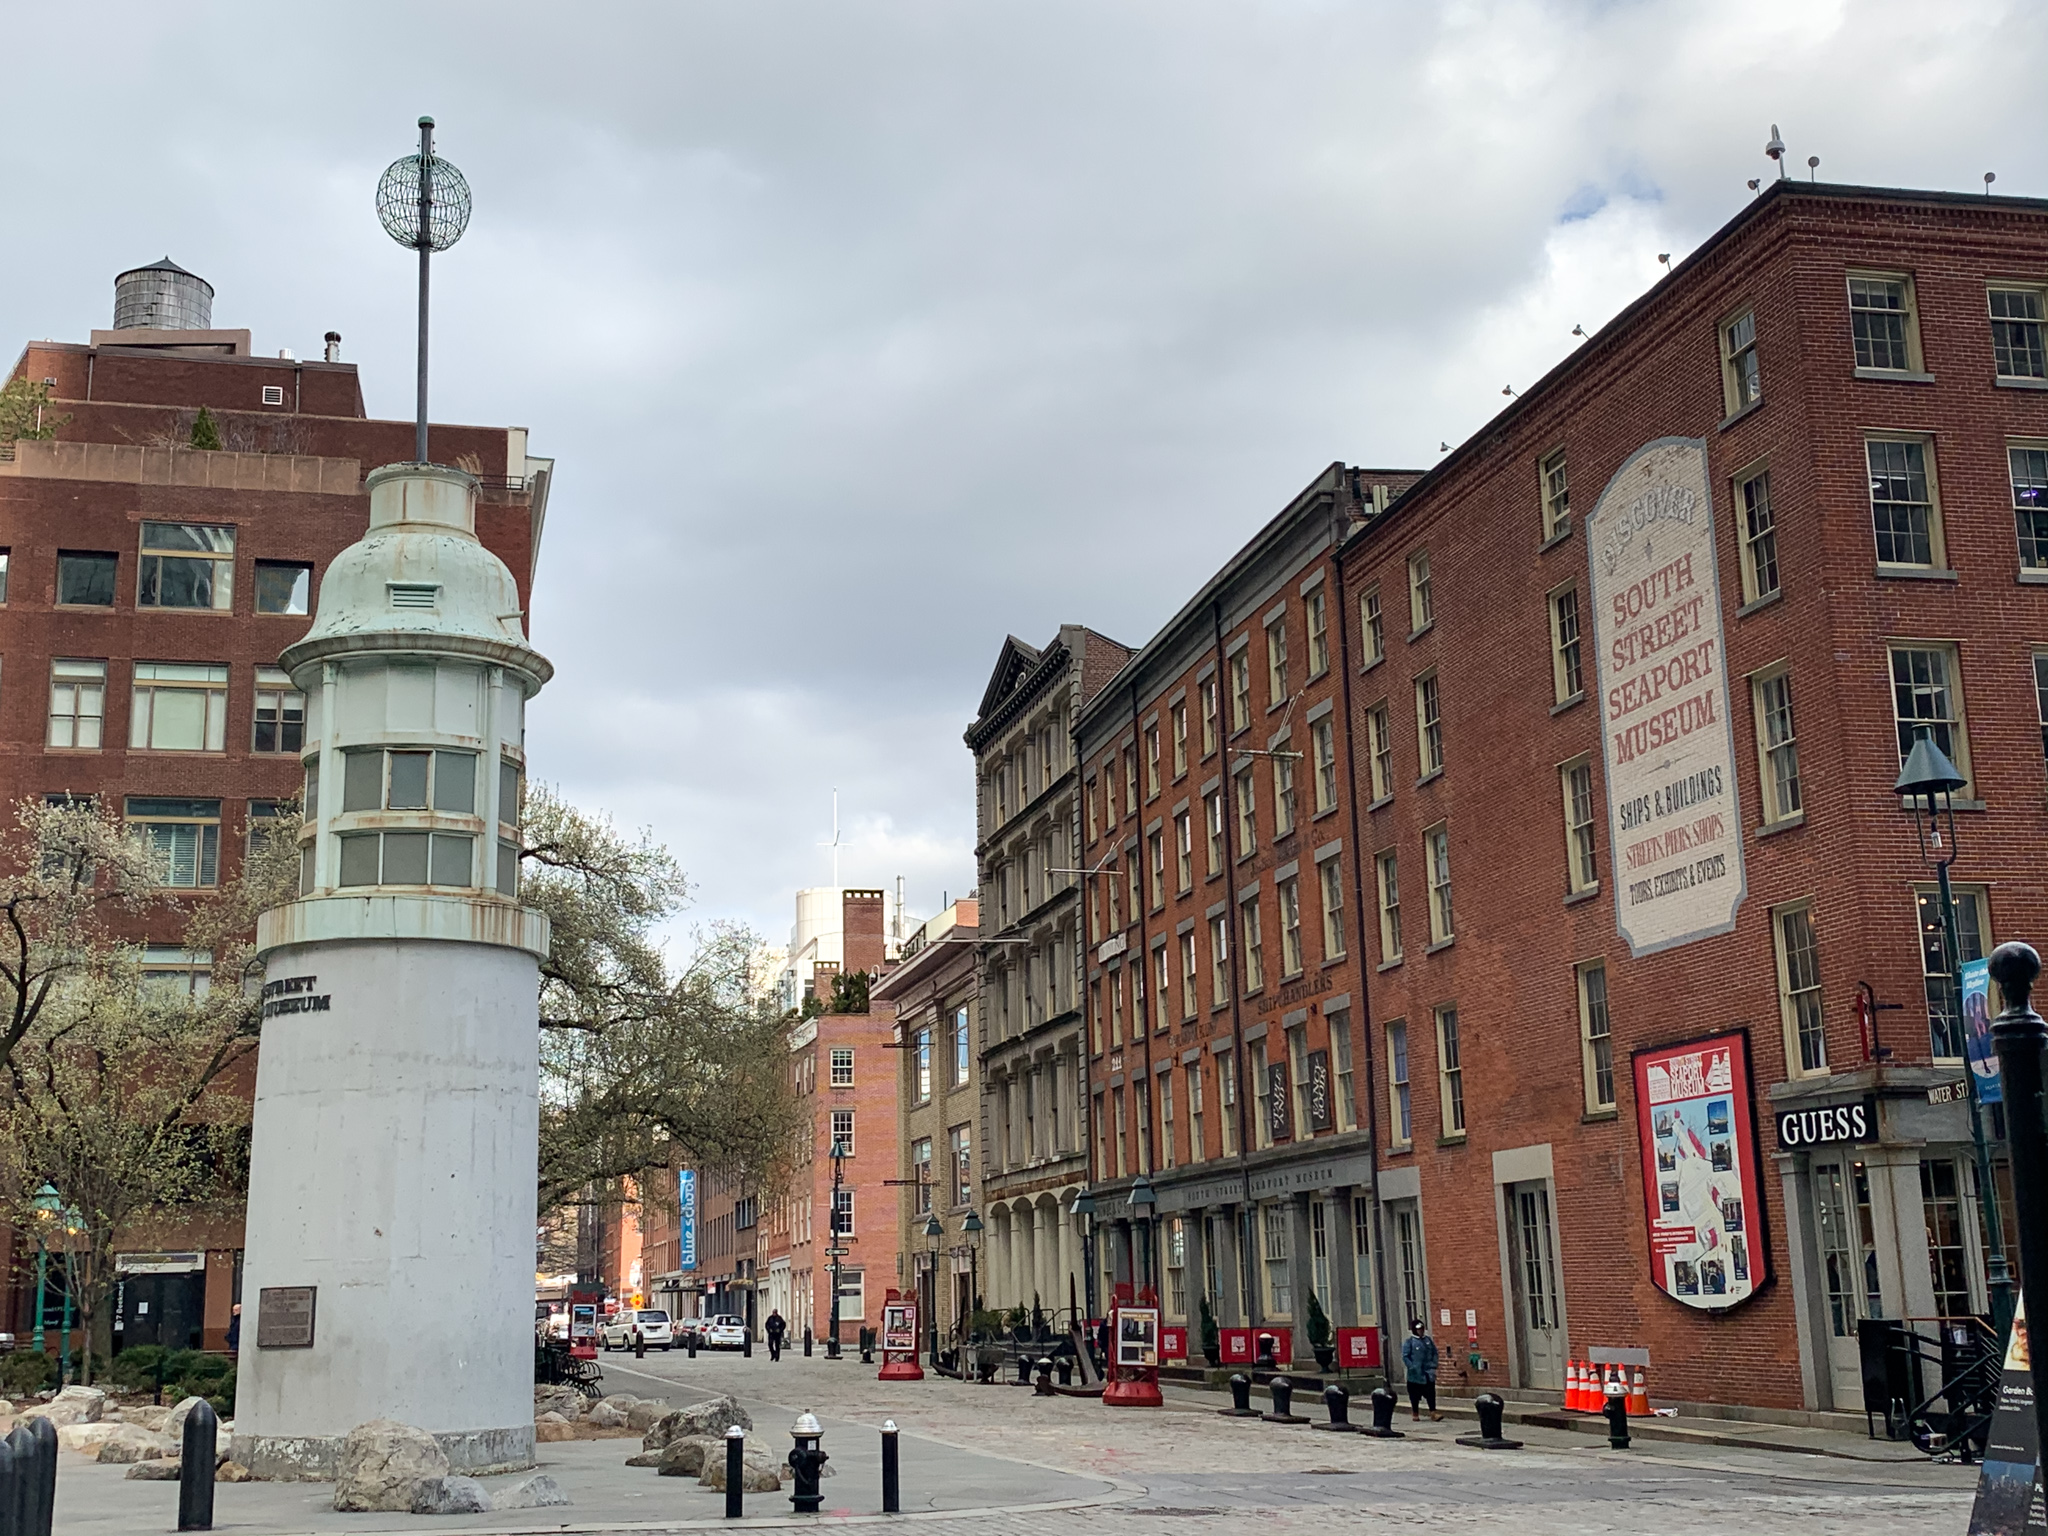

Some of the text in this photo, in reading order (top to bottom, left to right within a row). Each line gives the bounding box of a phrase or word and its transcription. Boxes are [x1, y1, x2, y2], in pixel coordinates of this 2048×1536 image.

[1600, 484, 1696, 576] DISCOVER
[1613, 553, 1694, 628] SOUTH
[1612, 595, 1704, 673] STREET
[1609, 639, 1715, 720] SEAPORT
[1615, 690, 1716, 765] MUSEUM
[1620, 764, 1723, 831] SHIPS & BUILDINGS
[1692, 811, 1725, 847] SHOPS
[1689, 863, 1696, 888] &
[1696, 853, 1726, 885] EVENTS
[1670, 1064, 1703, 1082] SEAPORT
[1671, 1078, 1705, 1099] MUSEUM
[1927, 1082, 1966, 1105] WATER ST
[1782, 1105, 1867, 1145] GUESS
[1295, 1168, 1333, 1184] MUSEUM
[681, 1176, 695, 1265] blue school
[2002, 1385, 2026, 1396] Garden
